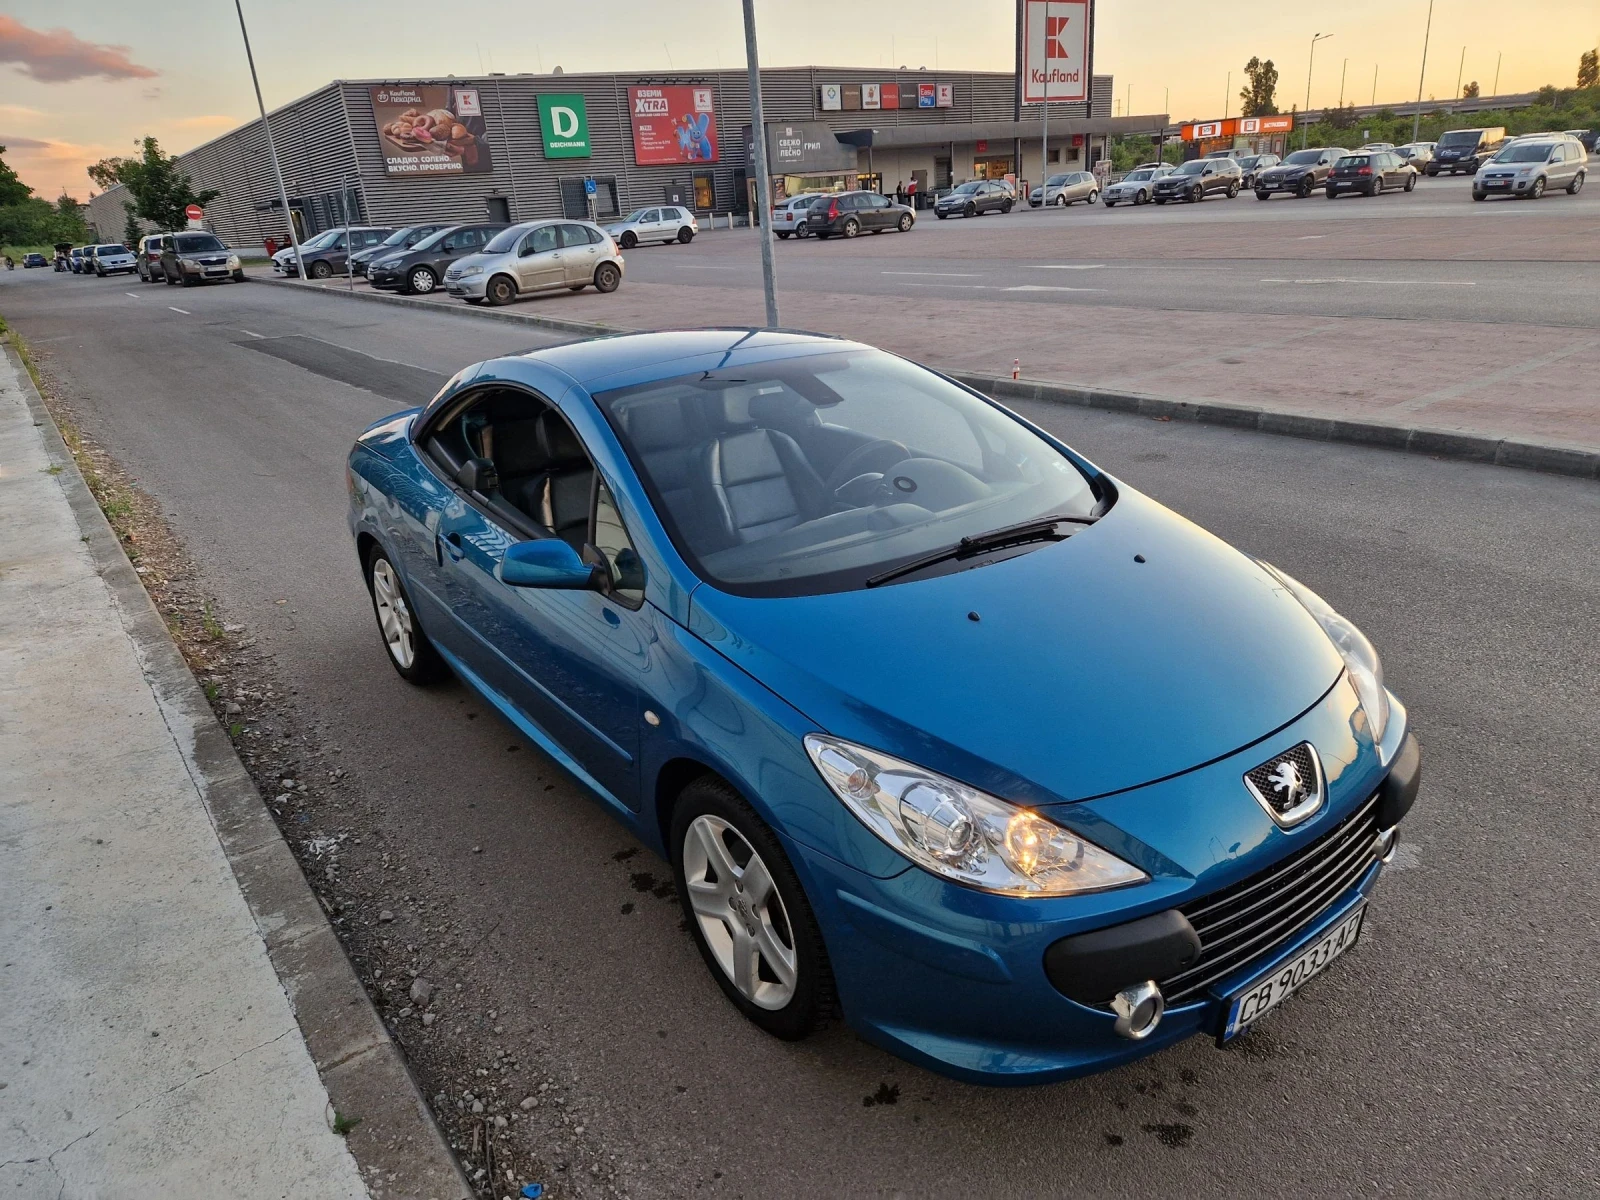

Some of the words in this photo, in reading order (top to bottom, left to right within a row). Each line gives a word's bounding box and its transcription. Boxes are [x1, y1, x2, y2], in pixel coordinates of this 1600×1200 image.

[1032, 69, 1079, 83] Kaufland
[637, 89, 662, 98] ВЗЕМИ
[920, 88, 934, 97] Easy
[635, 98, 669, 112] XTRA
[920, 97, 932, 105] Pay
[550, 106, 579, 138] D
[779, 139, 801, 147] СВЕЖО
[804, 142, 821, 150] ГРИЛ
[780, 149, 801, 157] ЛЕСНО
[386, 157, 420, 165] СЛАДКО.
[421, 155, 452, 163] СОЛЕНО.
[420, 163, 464, 171] ПРОВЕРЕНО.
[1240, 982, 1273, 1024] CB
[1279, 939, 1332, 998] 9033
[1332, 913, 1361, 954] AP
